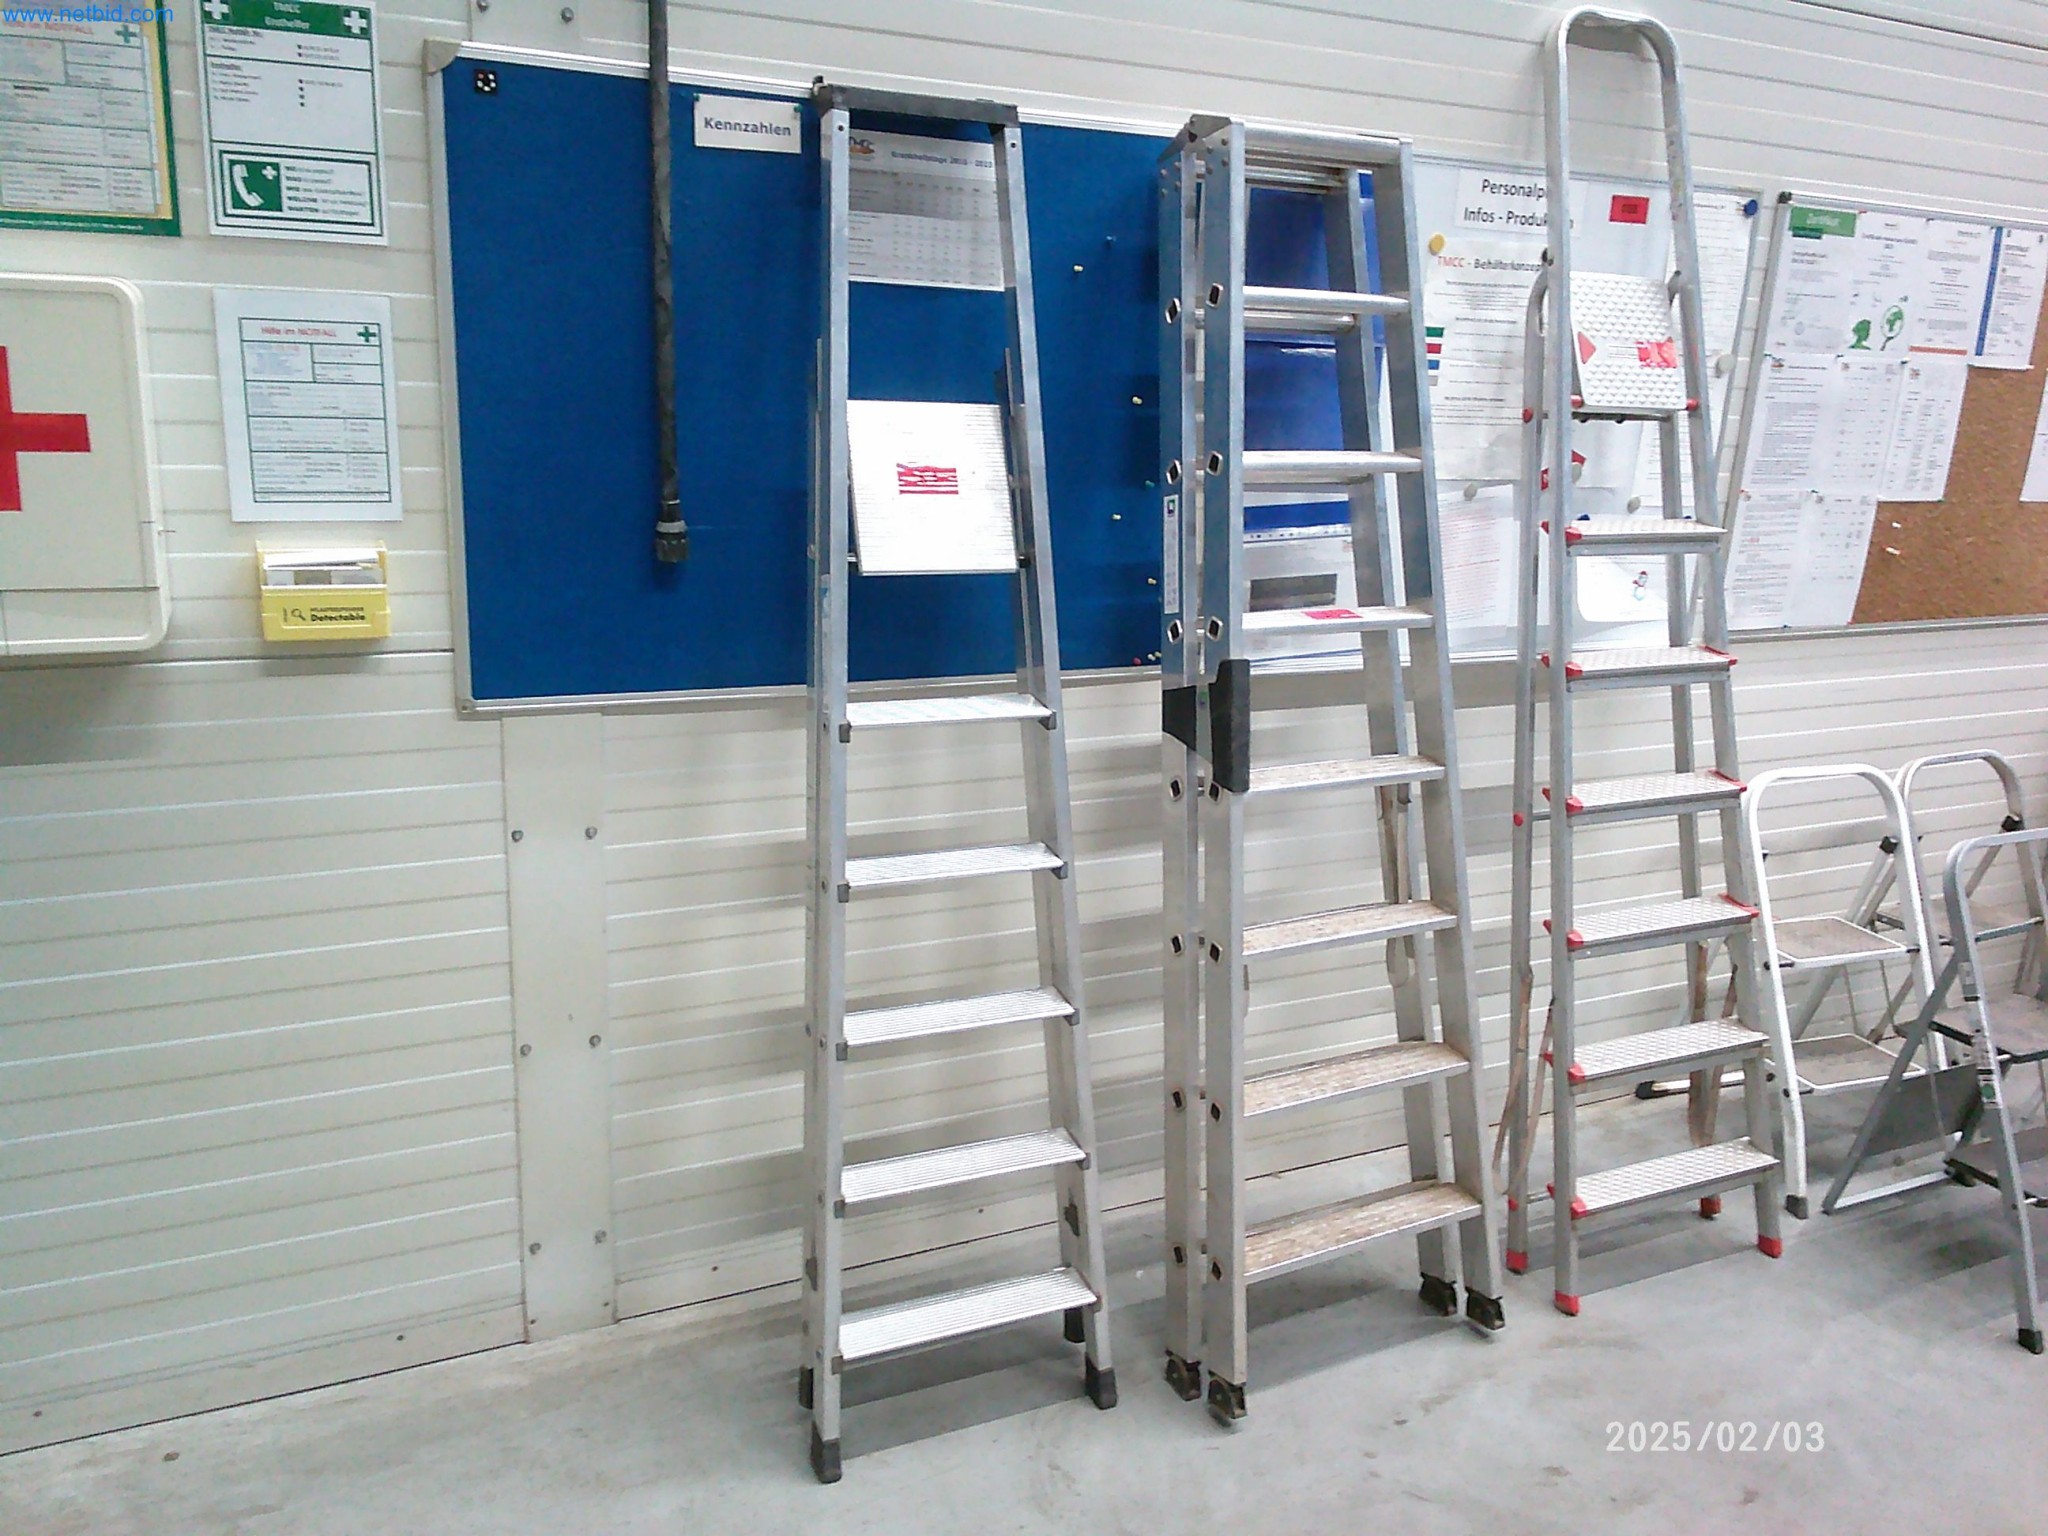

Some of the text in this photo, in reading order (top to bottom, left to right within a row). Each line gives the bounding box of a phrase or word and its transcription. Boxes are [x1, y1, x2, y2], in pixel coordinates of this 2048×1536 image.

[703, 116, 792, 136] Kennzahlen
[1482, 179, 1547, 201] Personalp
[1464, 206, 1495, 223] Infos
[311, 613, 365, 621] Detectable
